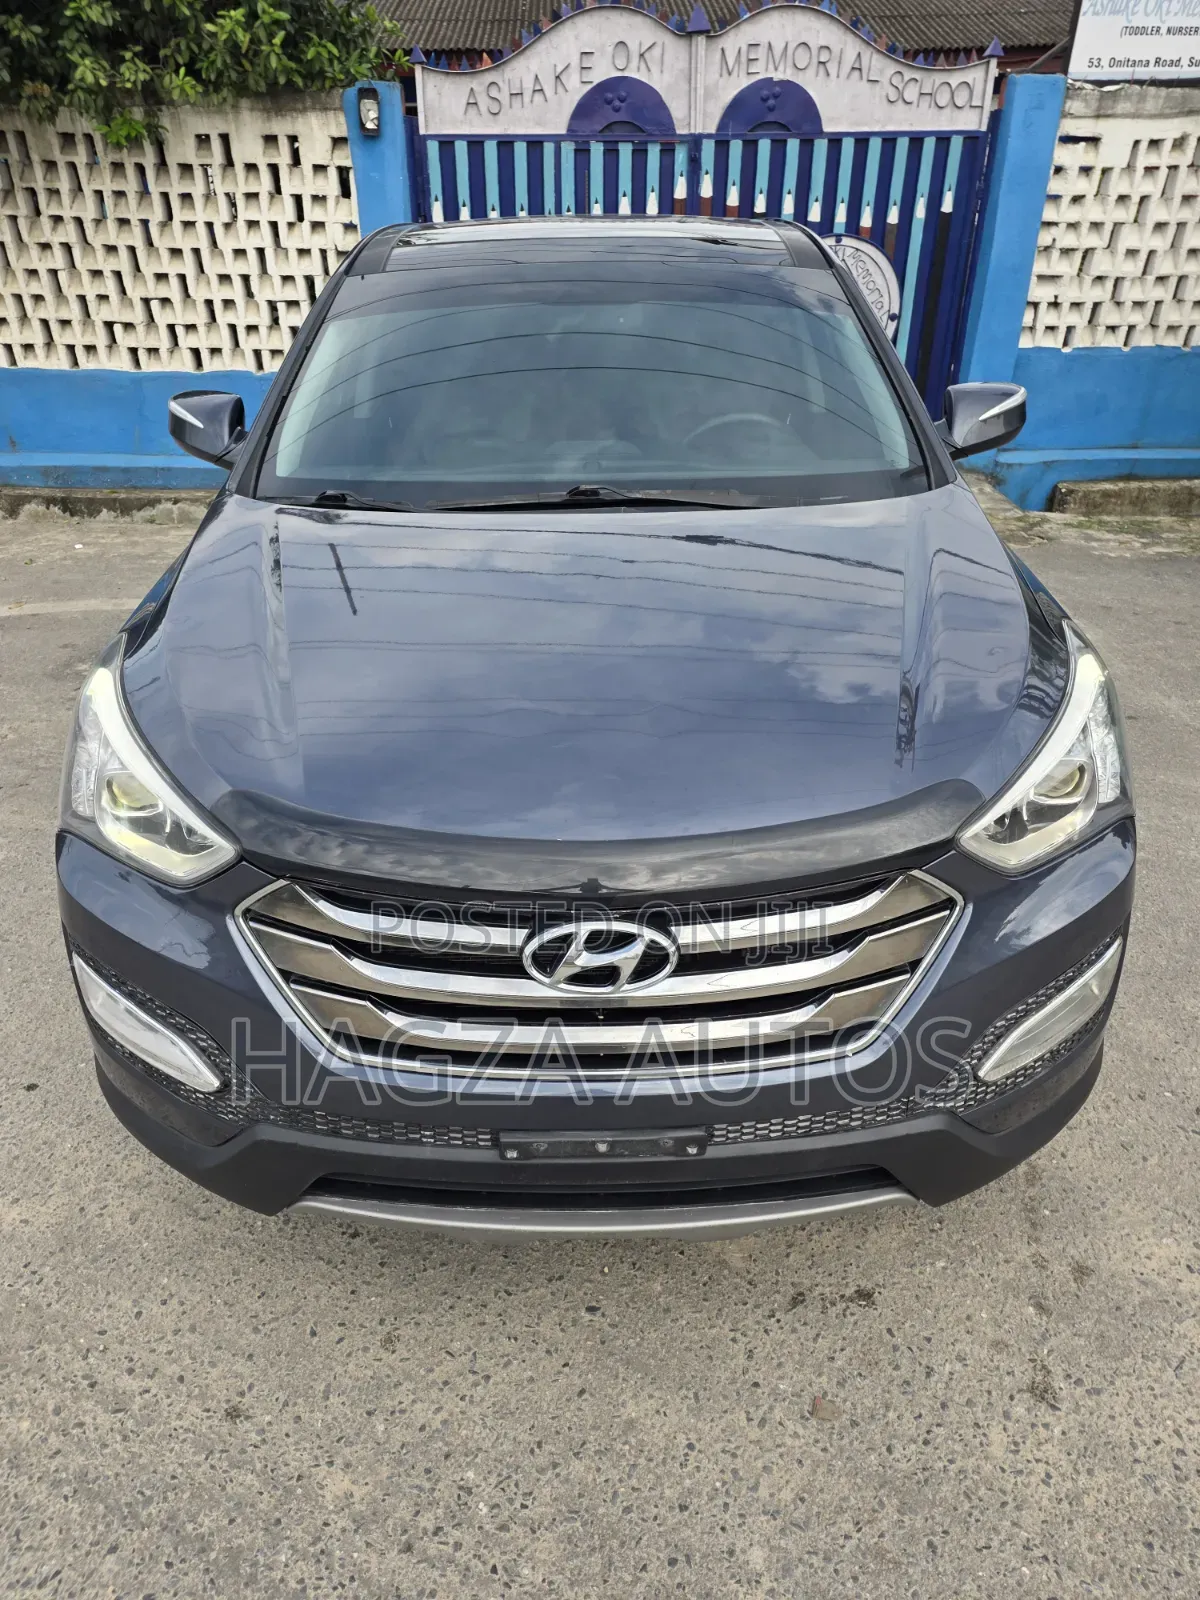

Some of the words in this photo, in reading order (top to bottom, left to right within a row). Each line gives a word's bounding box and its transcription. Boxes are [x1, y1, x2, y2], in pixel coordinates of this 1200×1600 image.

[1120, 26, 1163, 38] (TODDLER,
[1087, 57, 1104, 70] 53,
[1108, 57, 1150, 69] Onitana
[1153, 57, 1183, 70] Road,
[464, 51, 595, 116] ASHAKE
[612, 40, 665, 74] OKI
[719, 41, 880, 83] MEMORIAL
[886, 70, 984, 109] SCHOOL
